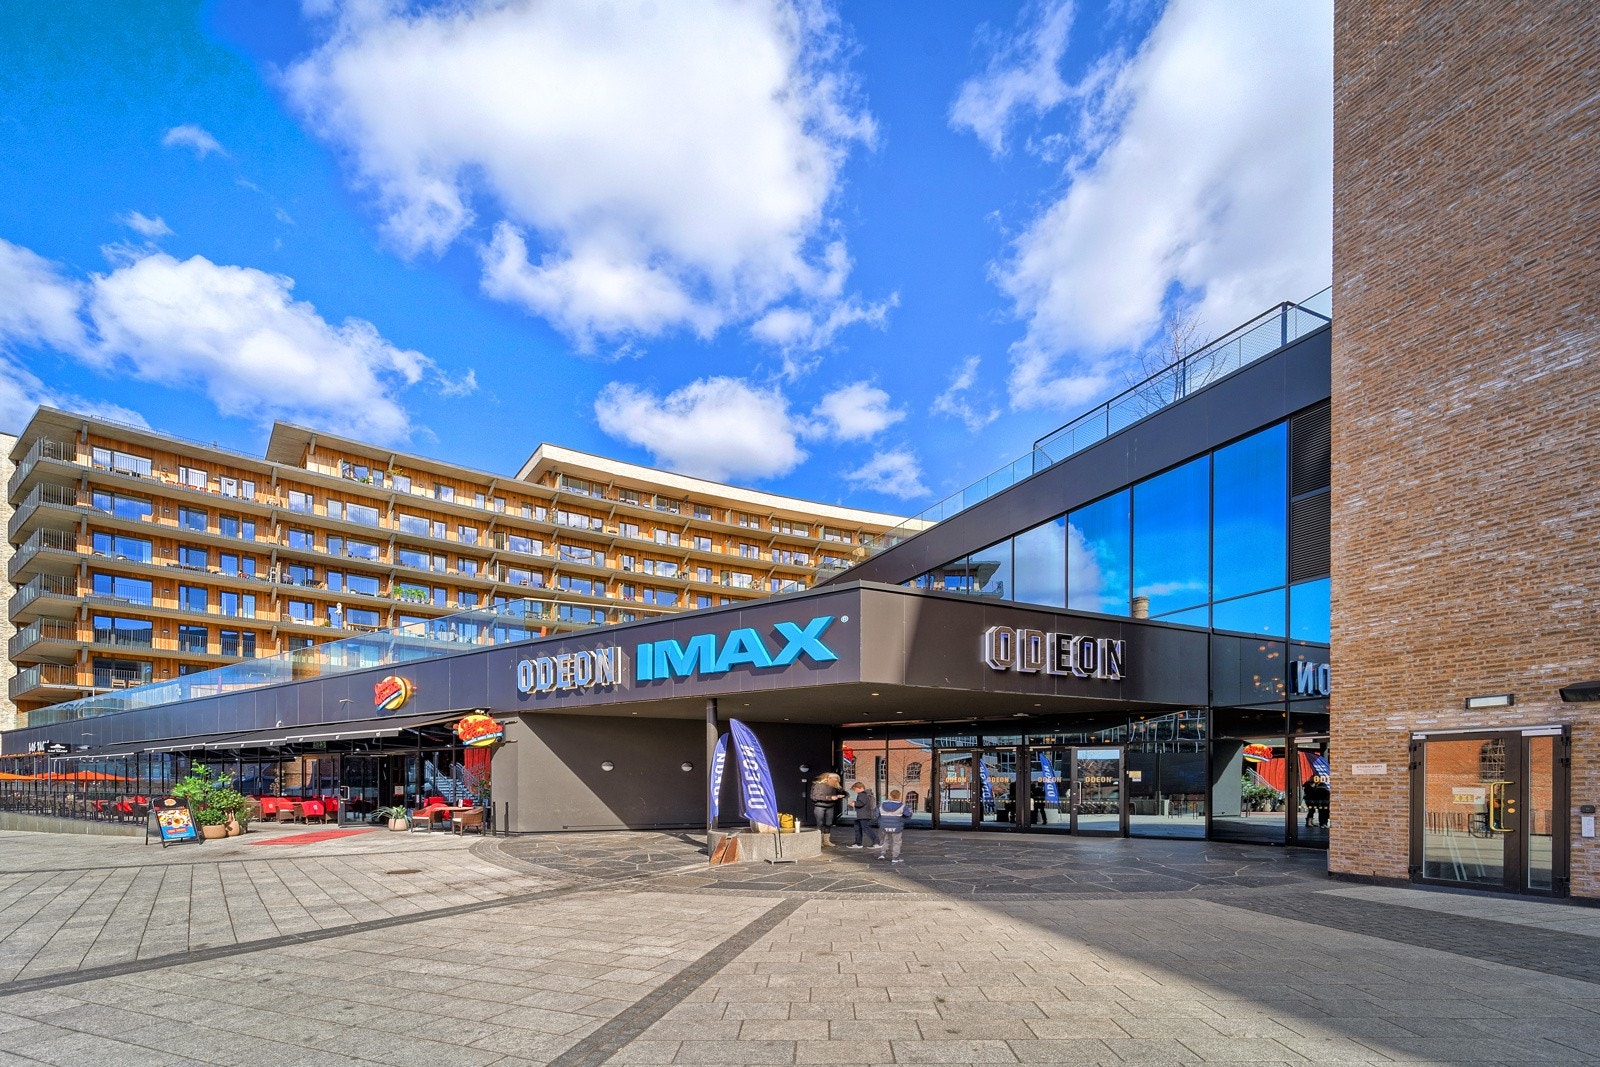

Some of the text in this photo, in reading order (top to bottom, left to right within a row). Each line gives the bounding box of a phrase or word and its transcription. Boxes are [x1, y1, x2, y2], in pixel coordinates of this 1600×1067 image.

[516, 615, 838, 695] ODEON IMAX
[985, 625, 1127, 681] ODEON
